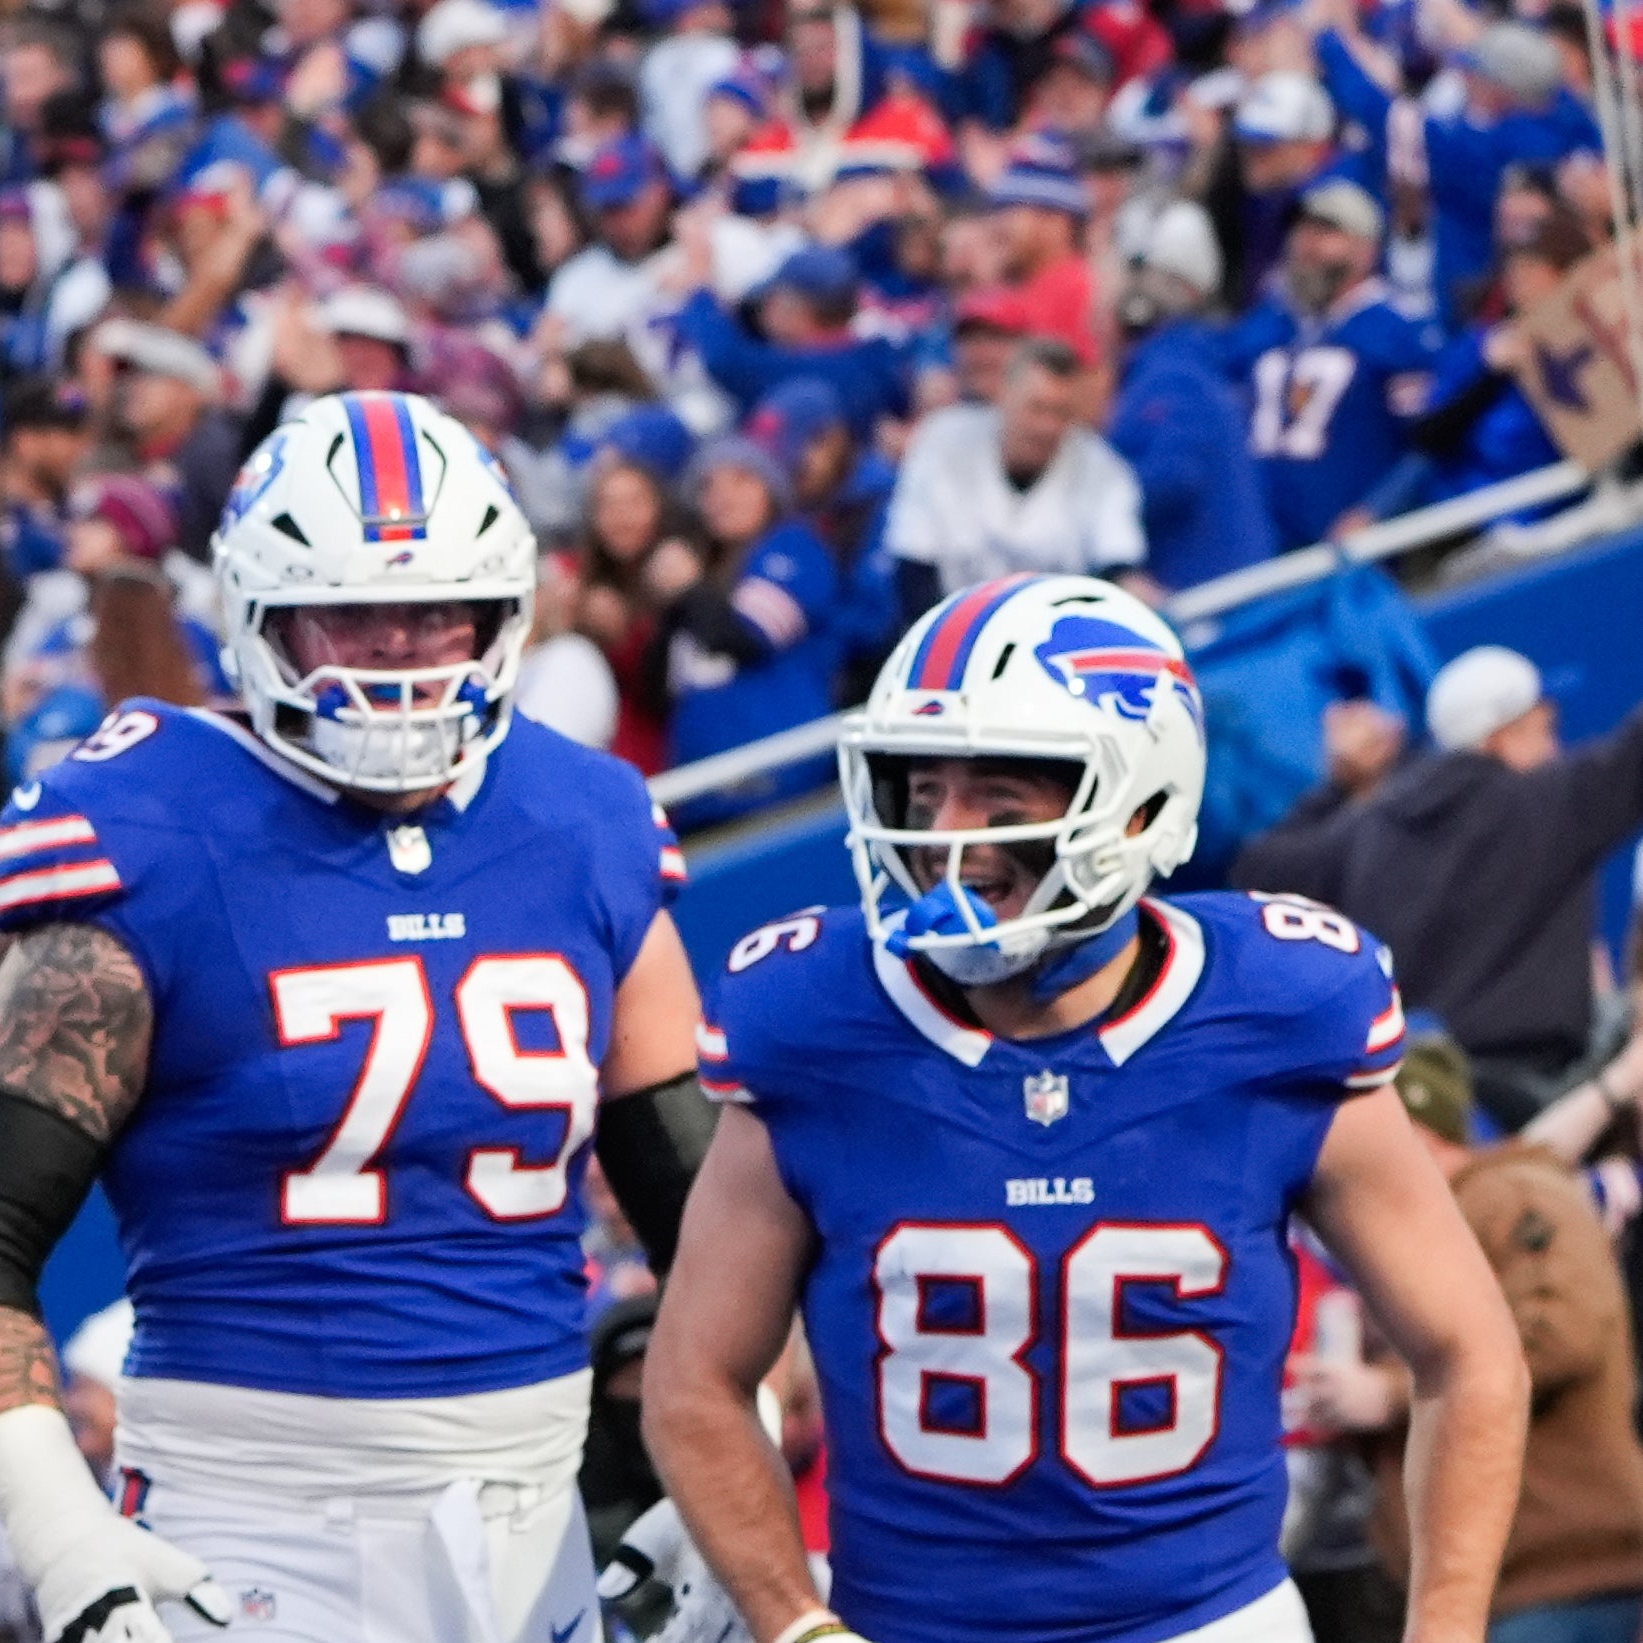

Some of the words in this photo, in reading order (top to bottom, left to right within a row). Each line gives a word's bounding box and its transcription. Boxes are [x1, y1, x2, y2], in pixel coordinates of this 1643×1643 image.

[727, 905, 824, 973] 6
[1247, 890, 1360, 954] 8
[268, 952, 598, 1226] 79
[1005, 1177, 1095, 1206] BILLS
[871, 1219, 1231, 1490] 86
